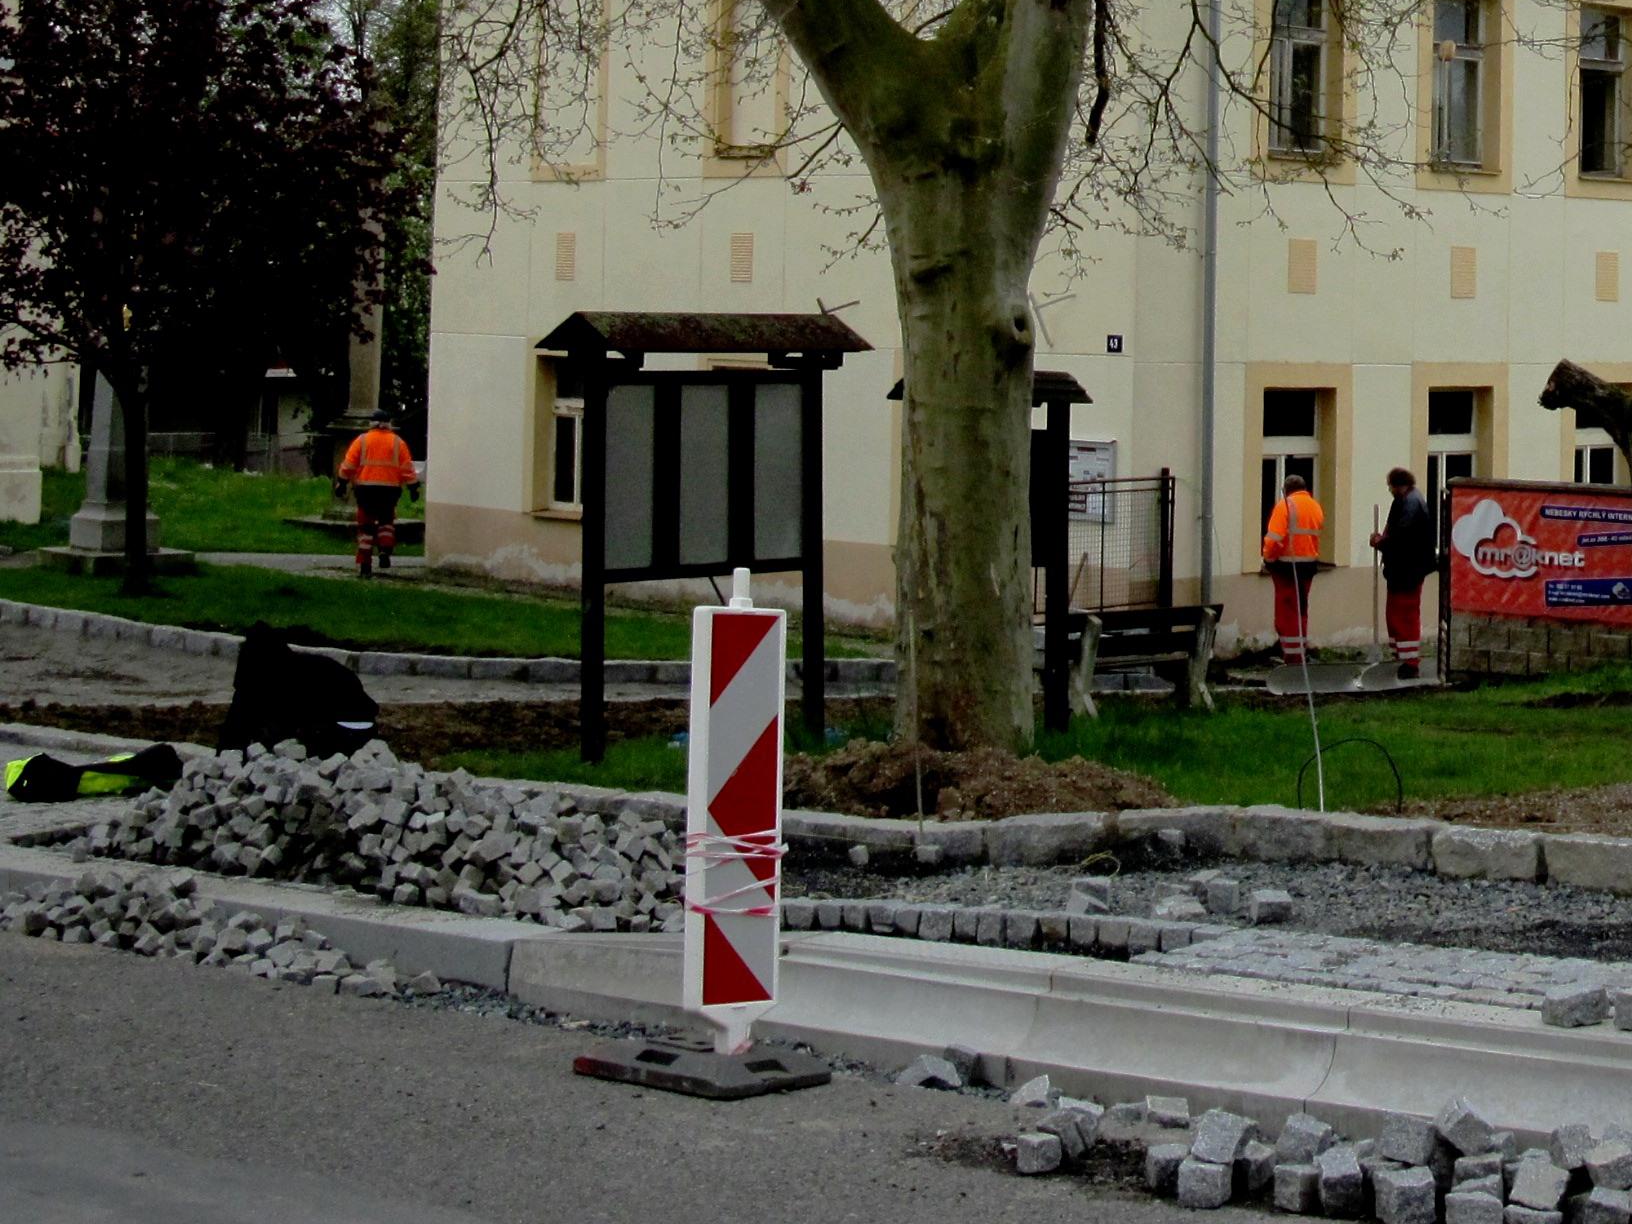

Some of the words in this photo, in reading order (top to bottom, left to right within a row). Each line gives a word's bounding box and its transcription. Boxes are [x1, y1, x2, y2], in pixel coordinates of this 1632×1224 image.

[1109, 338, 1118, 349] 43
[1545, 509, 1577, 517] NEBESKY
[1477, 545, 1585, 569] mr@knet
